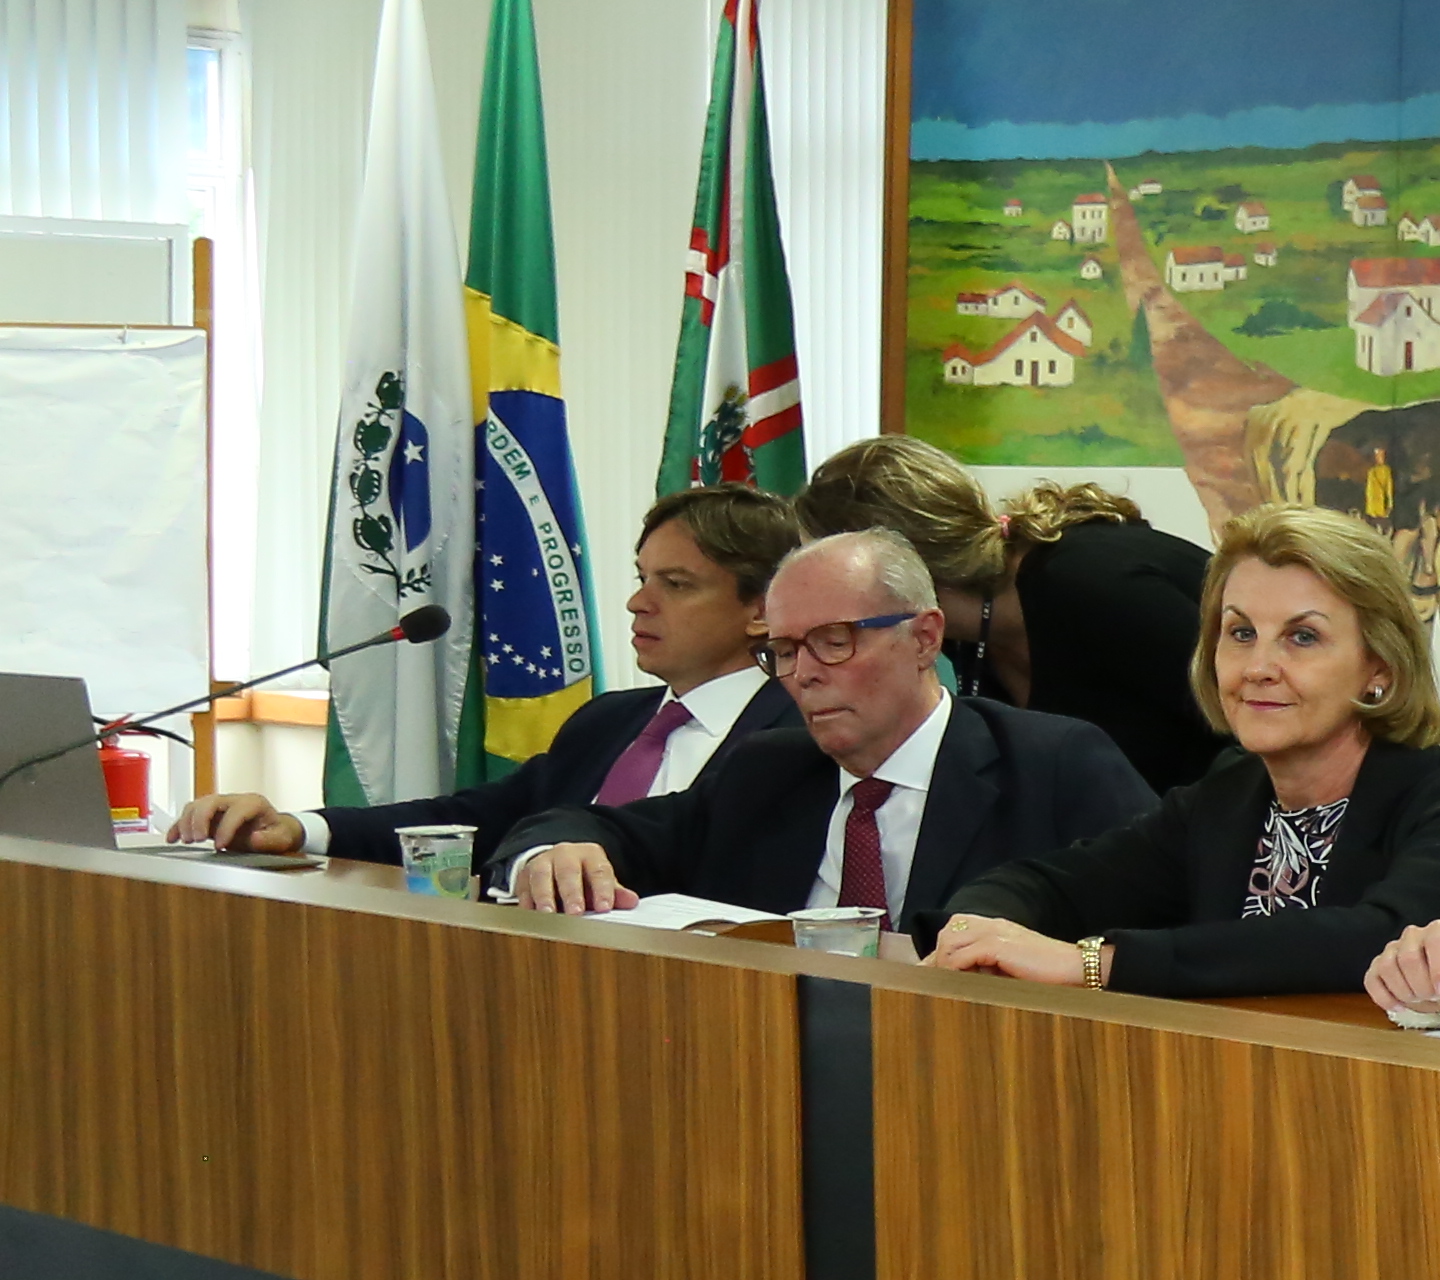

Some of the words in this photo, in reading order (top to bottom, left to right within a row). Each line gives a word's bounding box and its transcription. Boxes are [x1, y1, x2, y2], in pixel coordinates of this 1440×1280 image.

[487, 420, 532, 481] RDEM
[529, 494, 540, 505] E
[538, 521, 585, 673] PROGRESSO
